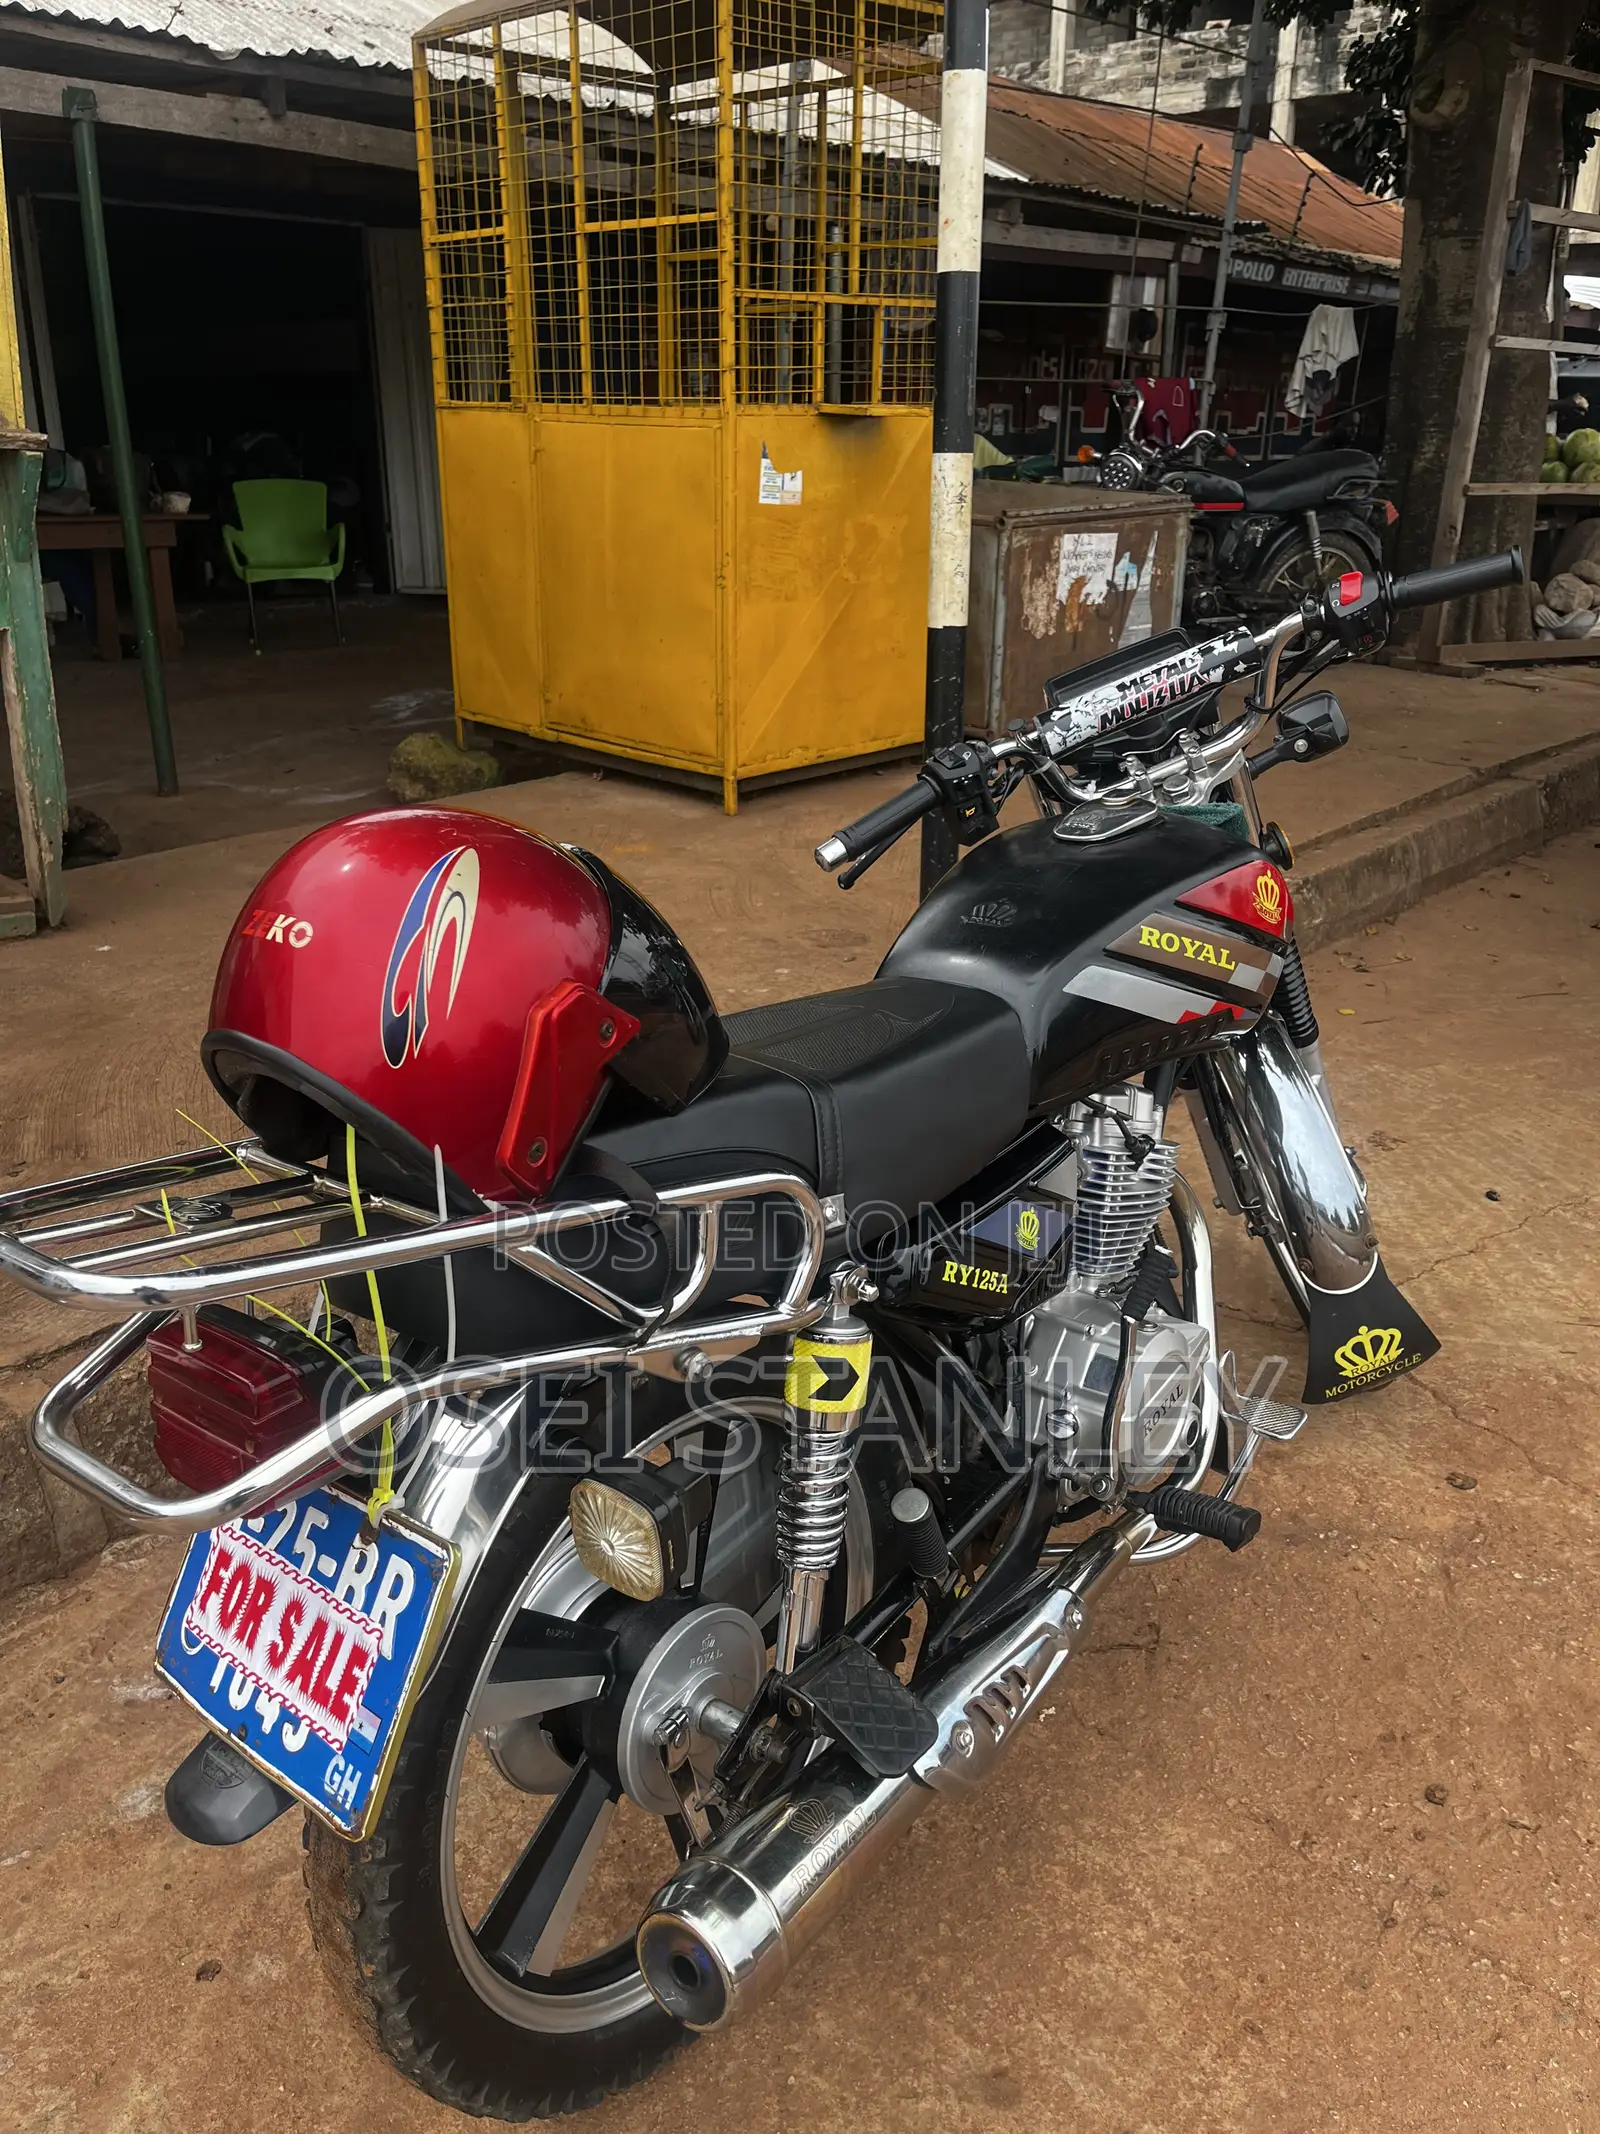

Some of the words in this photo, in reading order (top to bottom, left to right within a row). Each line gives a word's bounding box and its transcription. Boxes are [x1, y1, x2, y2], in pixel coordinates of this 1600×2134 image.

[1282, 267, 1351, 294] ENTERPRISE
[242, 909, 314, 948] ZEKO
[1138, 925, 1235, 971] ROYAL
[942, 1260, 1009, 1294] RY125A
[1325, 1353, 1422, 1398] MOTORCYCLE
[1350, 1355, 1397, 1377] ROYAL
[1142, 1384, 1184, 1438] ROYAL
[197, 1541, 278, 1652] FOR
[263, 1588, 374, 1734] SALE
[323, 1754, 360, 1810] GH
[791, 1806, 877, 1897] ROYAL
